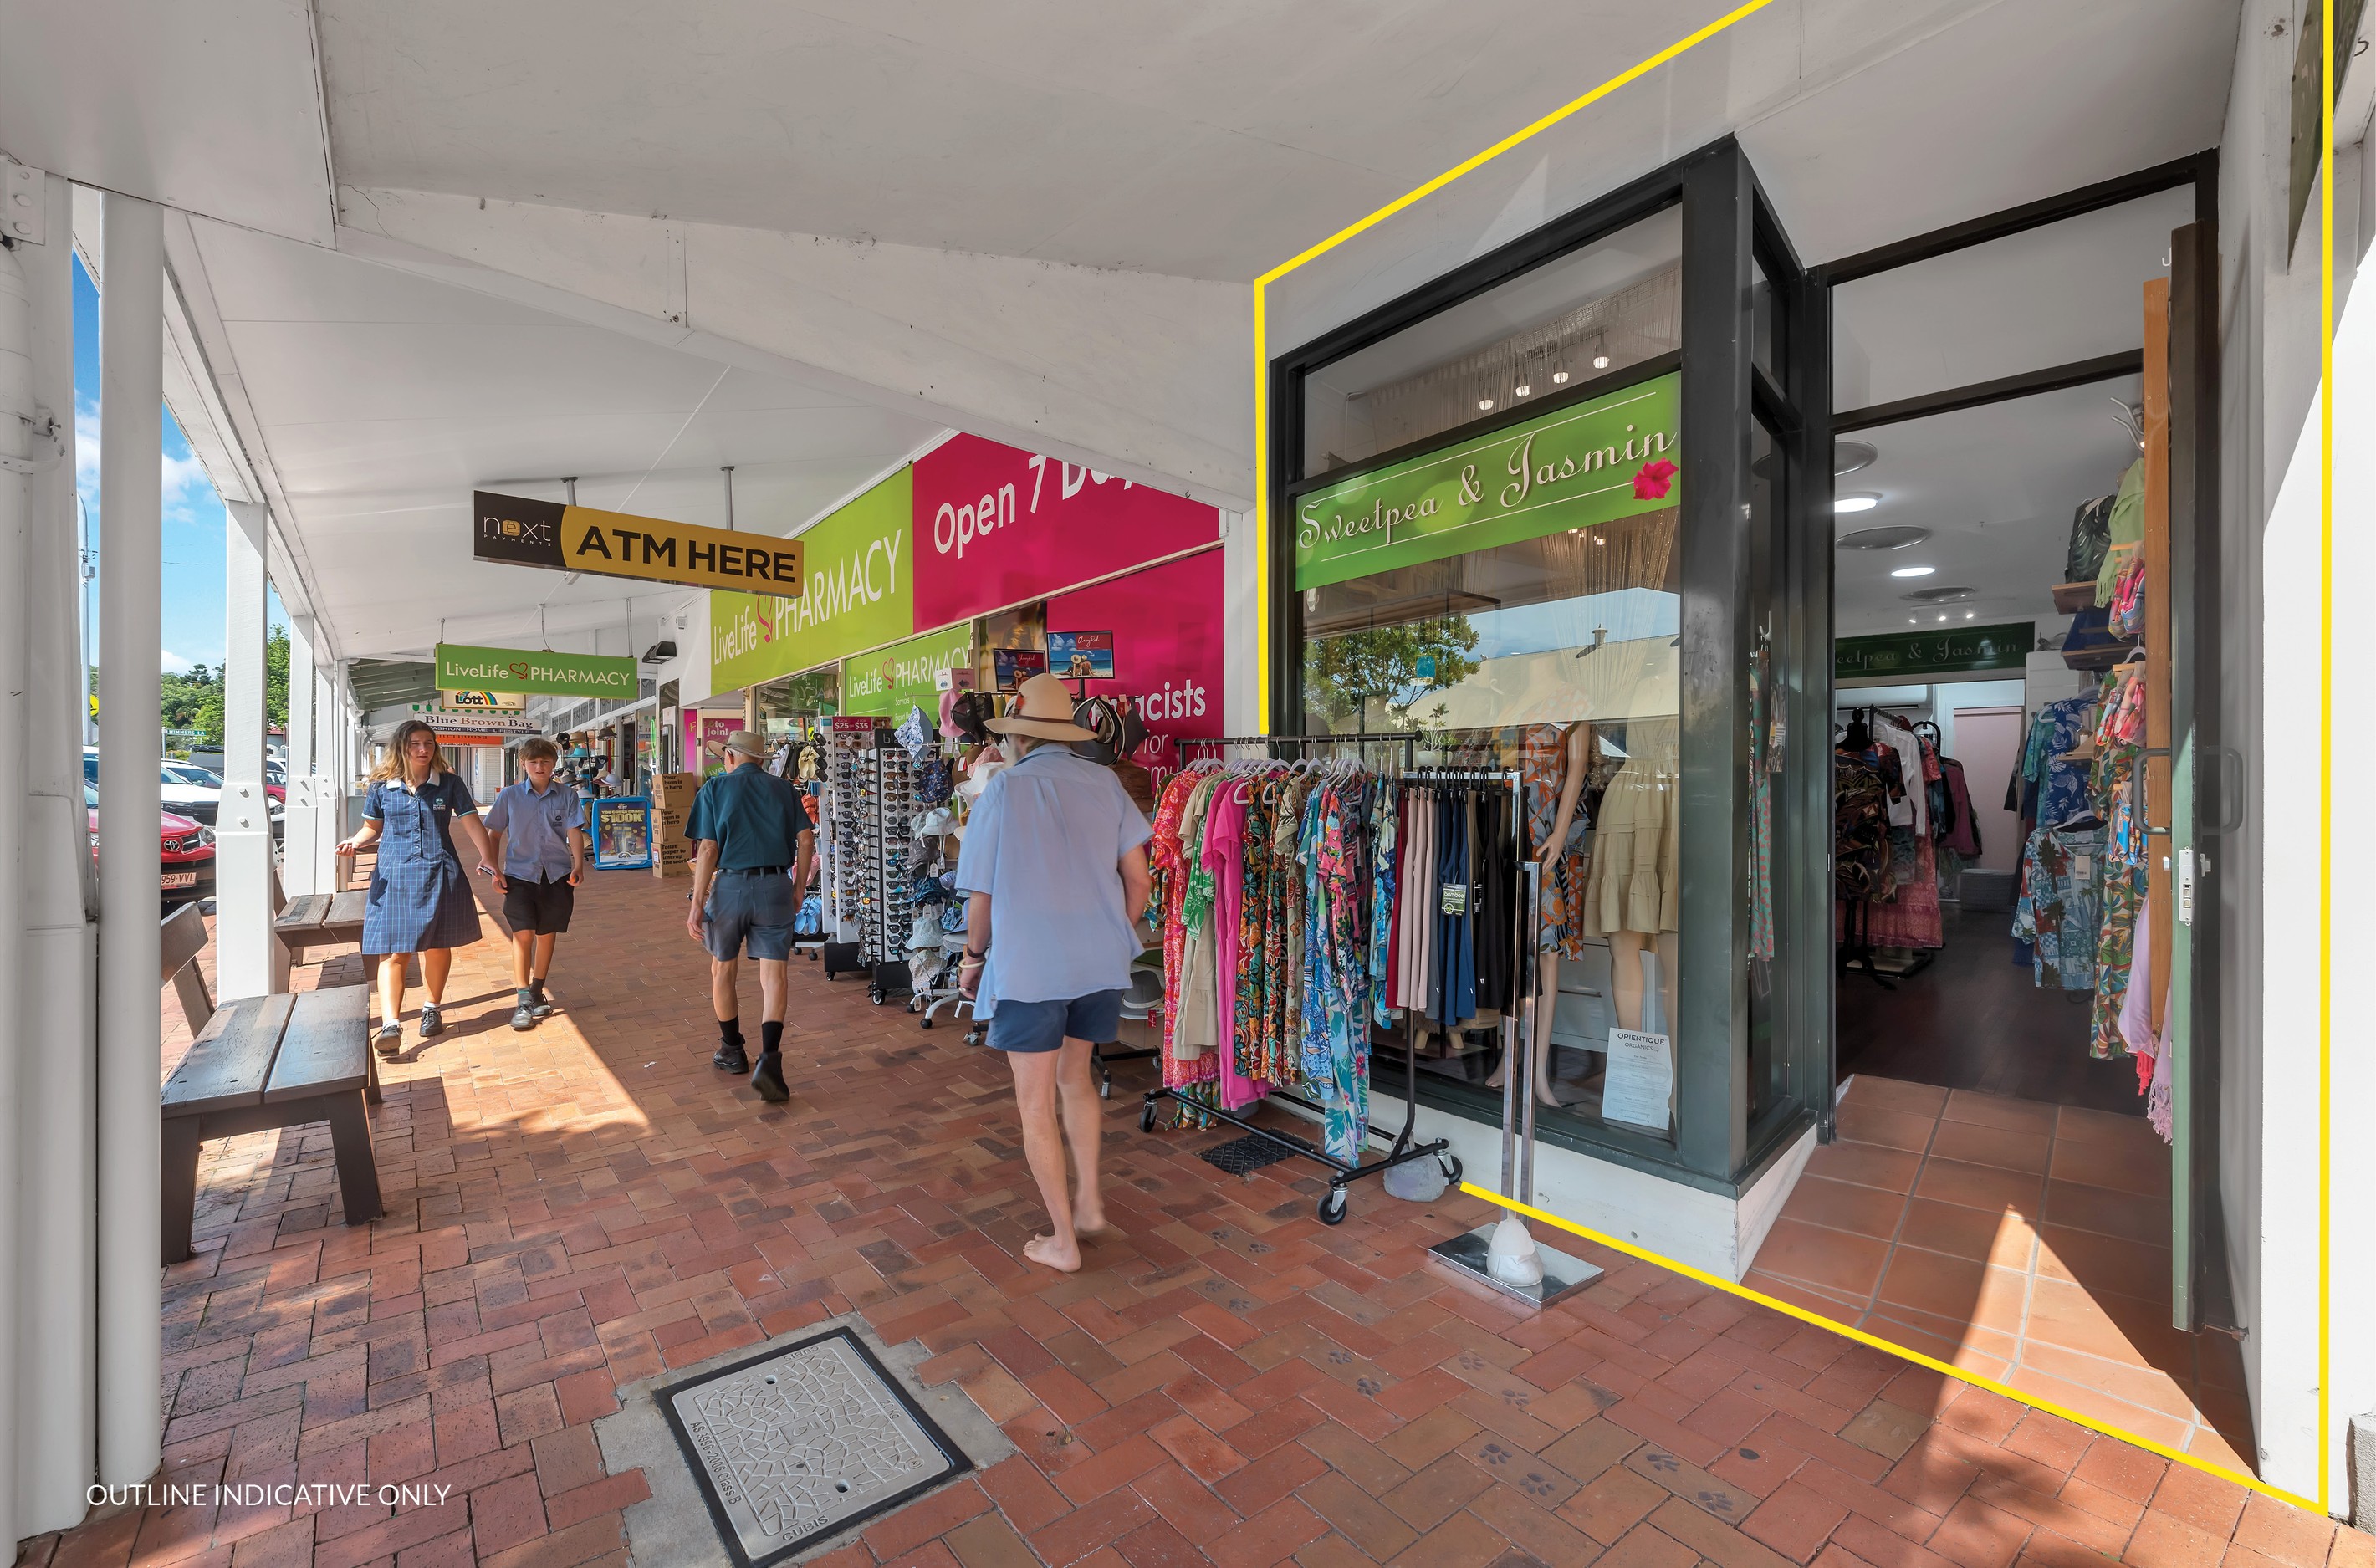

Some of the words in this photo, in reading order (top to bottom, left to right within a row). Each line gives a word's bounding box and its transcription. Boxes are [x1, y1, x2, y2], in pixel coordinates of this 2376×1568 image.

[1298, 497, 1443, 550] Sweetpea
[1458, 464, 1484, 507] &
[1500, 424, 1678, 508] Jasmin
[934, 483, 1016, 559] Open
[1028, 454, 1047, 514] 7
[483, 516, 551, 542] next
[483, 534, 551, 547] PAYMENTS
[575, 525, 677, 569] ATM
[688, 540, 795, 584] HERE
[713, 605, 757, 666] LiveLife
[775, 529, 902, 641] PHARMACY
[446, 661, 509, 680] LiveLife
[529, 667, 630, 687] PHARMACY
[849, 667, 883, 698] LiveLife
[425, 715, 457, 724] Blue
[460, 717, 506, 727] Brown
[508, 719, 534, 730] Bag
[707, 728, 728, 737] join!
[855, 722, 869, 730] $35
[600, 813, 643, 823] $100K
[1617, 1033, 1665, 1045] ORIENTIQUE
[1624, 1042, 1653, 1051] ORGANICS
[690, 1421, 706, 1433] AS
[717, 1471, 736, 1497] Class
[728, 1494, 743, 1505] B
[782, 1514, 830, 1542] CUBIS
